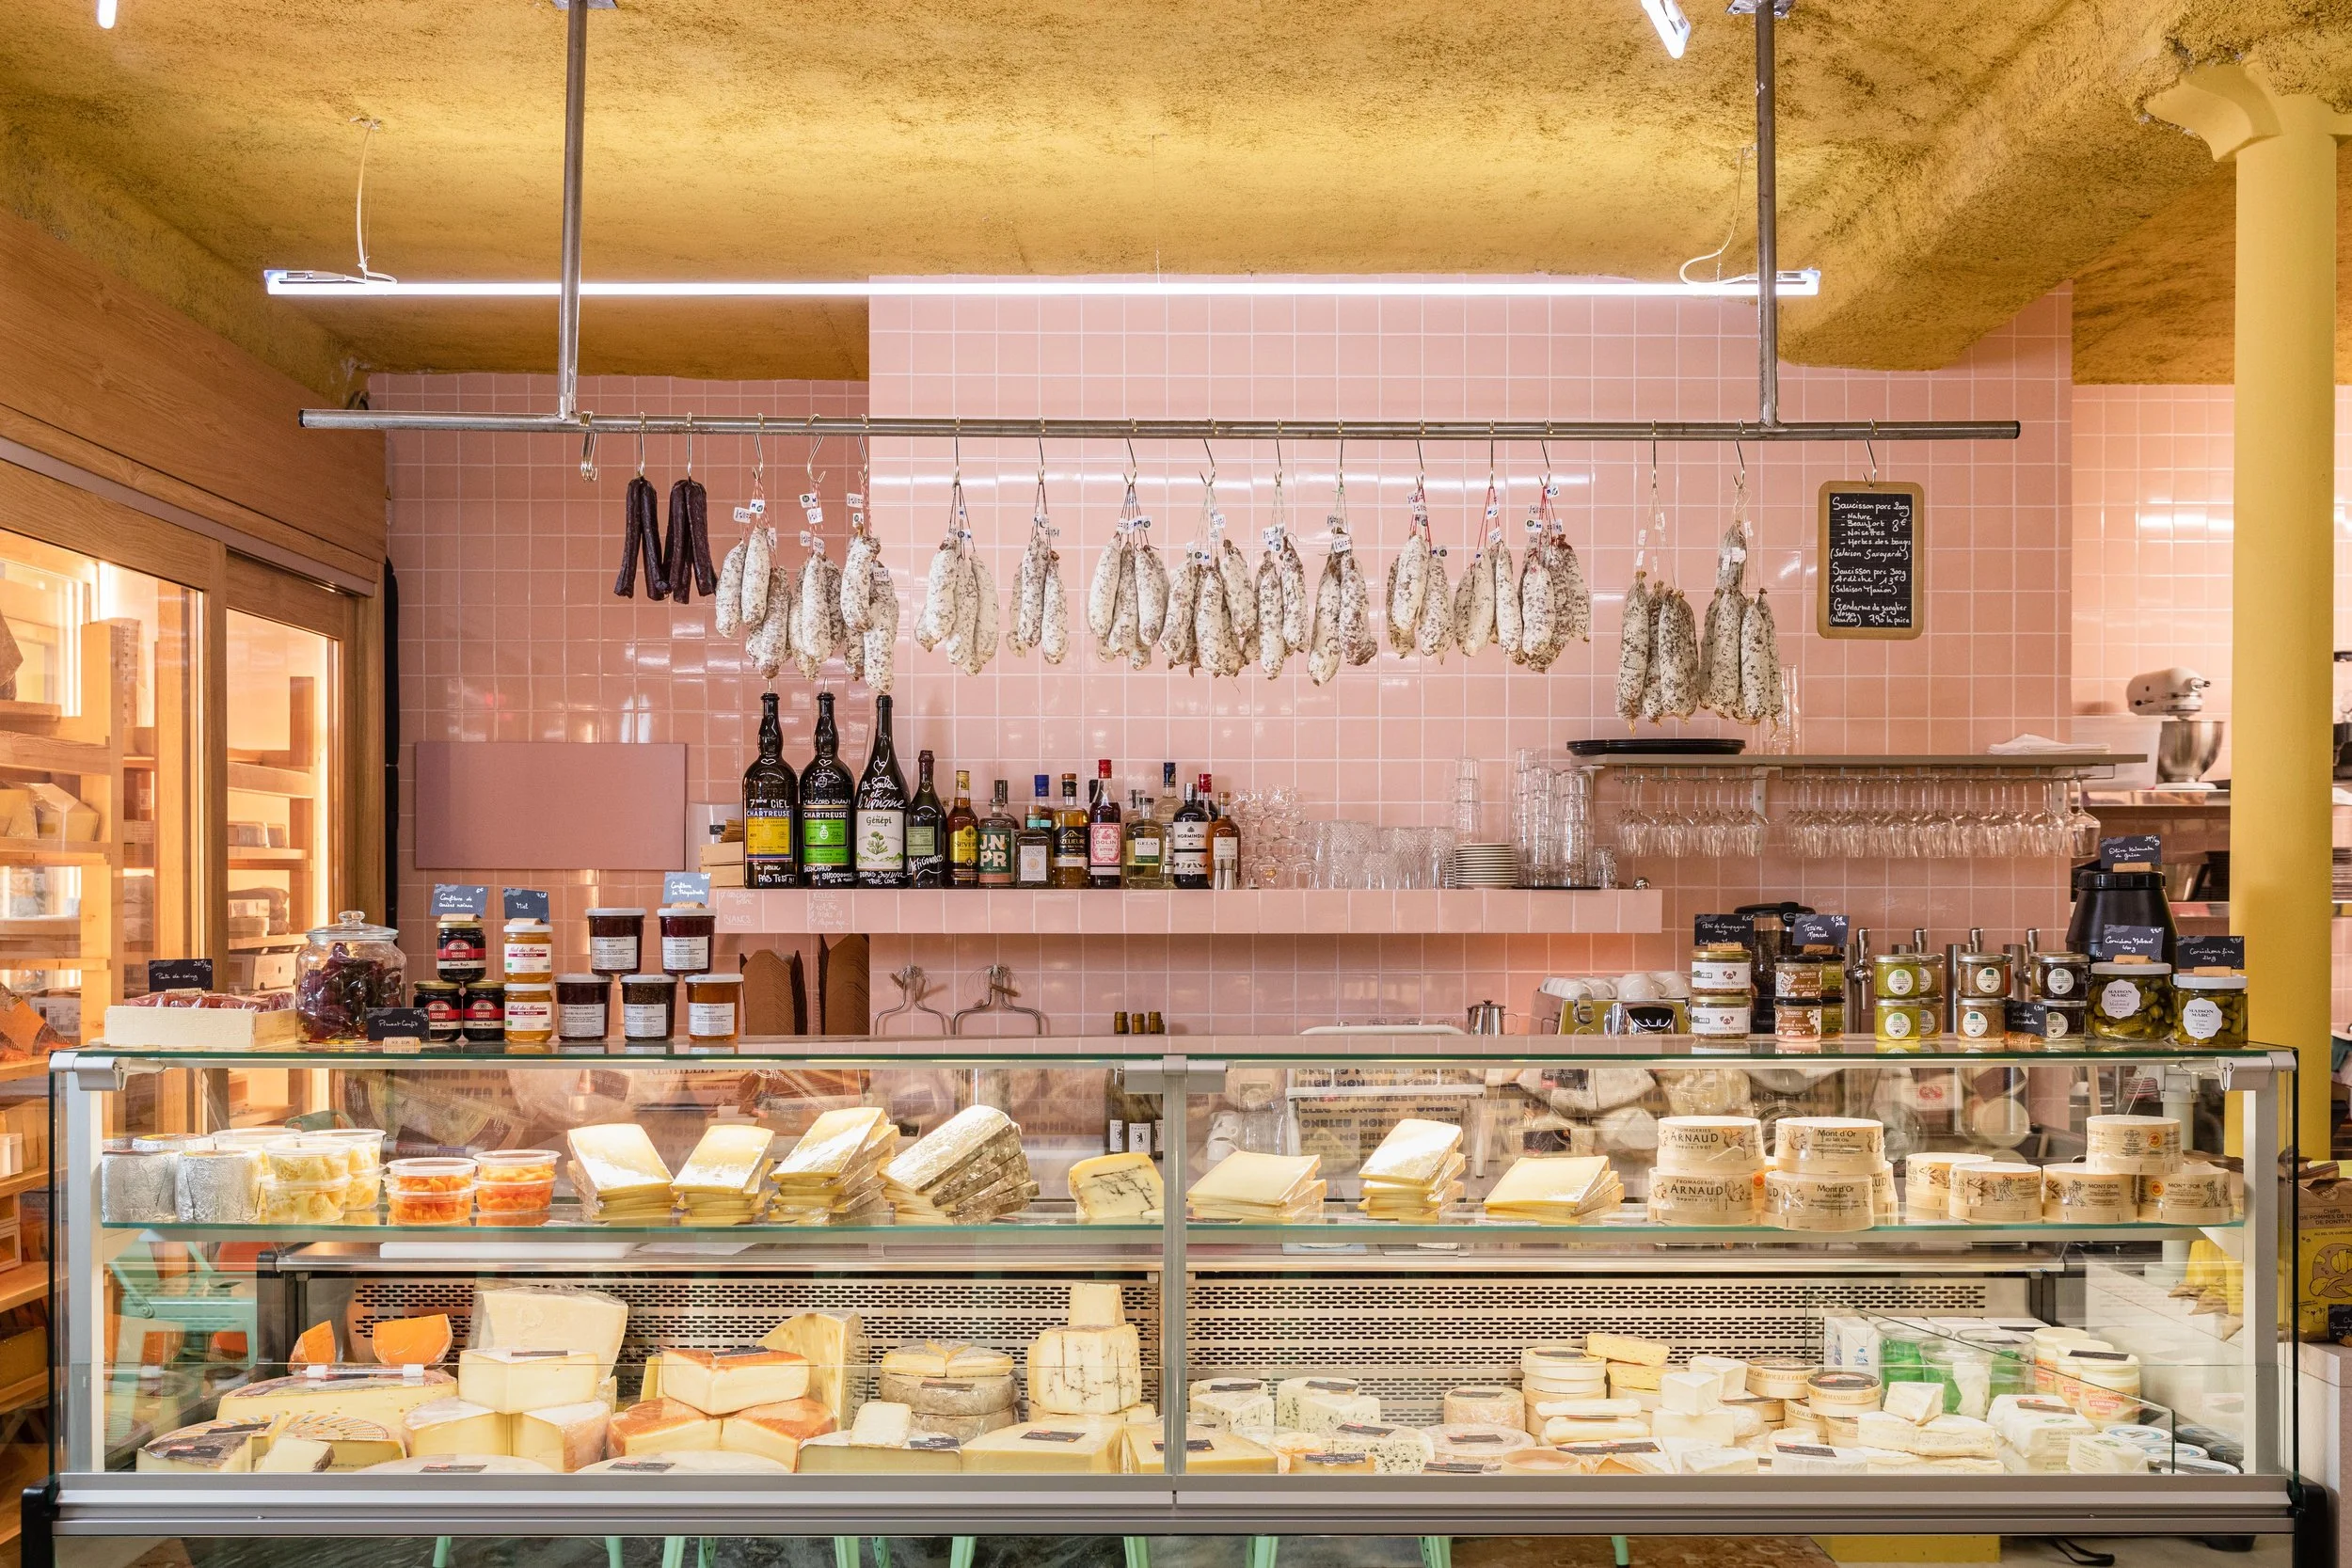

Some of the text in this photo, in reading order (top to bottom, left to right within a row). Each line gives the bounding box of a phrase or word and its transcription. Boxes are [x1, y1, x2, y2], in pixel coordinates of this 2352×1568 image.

[1832, 497, 1874, 510] Saucisson
[1875, 503, 1891, 515] porc
[1847, 519, 1885, 531] Beaufort
[1847, 528, 1885, 536] Noisettes
[1848, 538, 1872, 547] Herbes
[1832, 562, 1906, 582] Saucisson porc 300g
[1834, 598, 1871, 611] Gendarme
[1882, 602, 1907, 615] sanglier
[439, 894, 463, 904] Confiture
[1671, 1132, 1719, 1143] ARNAUD
[1817, 1129, 1857, 1137] Mont d'Or
[1670, 1185, 1724, 1196] ARNAUD
[1817, 1184, 1854, 1193] Mont d'Or
